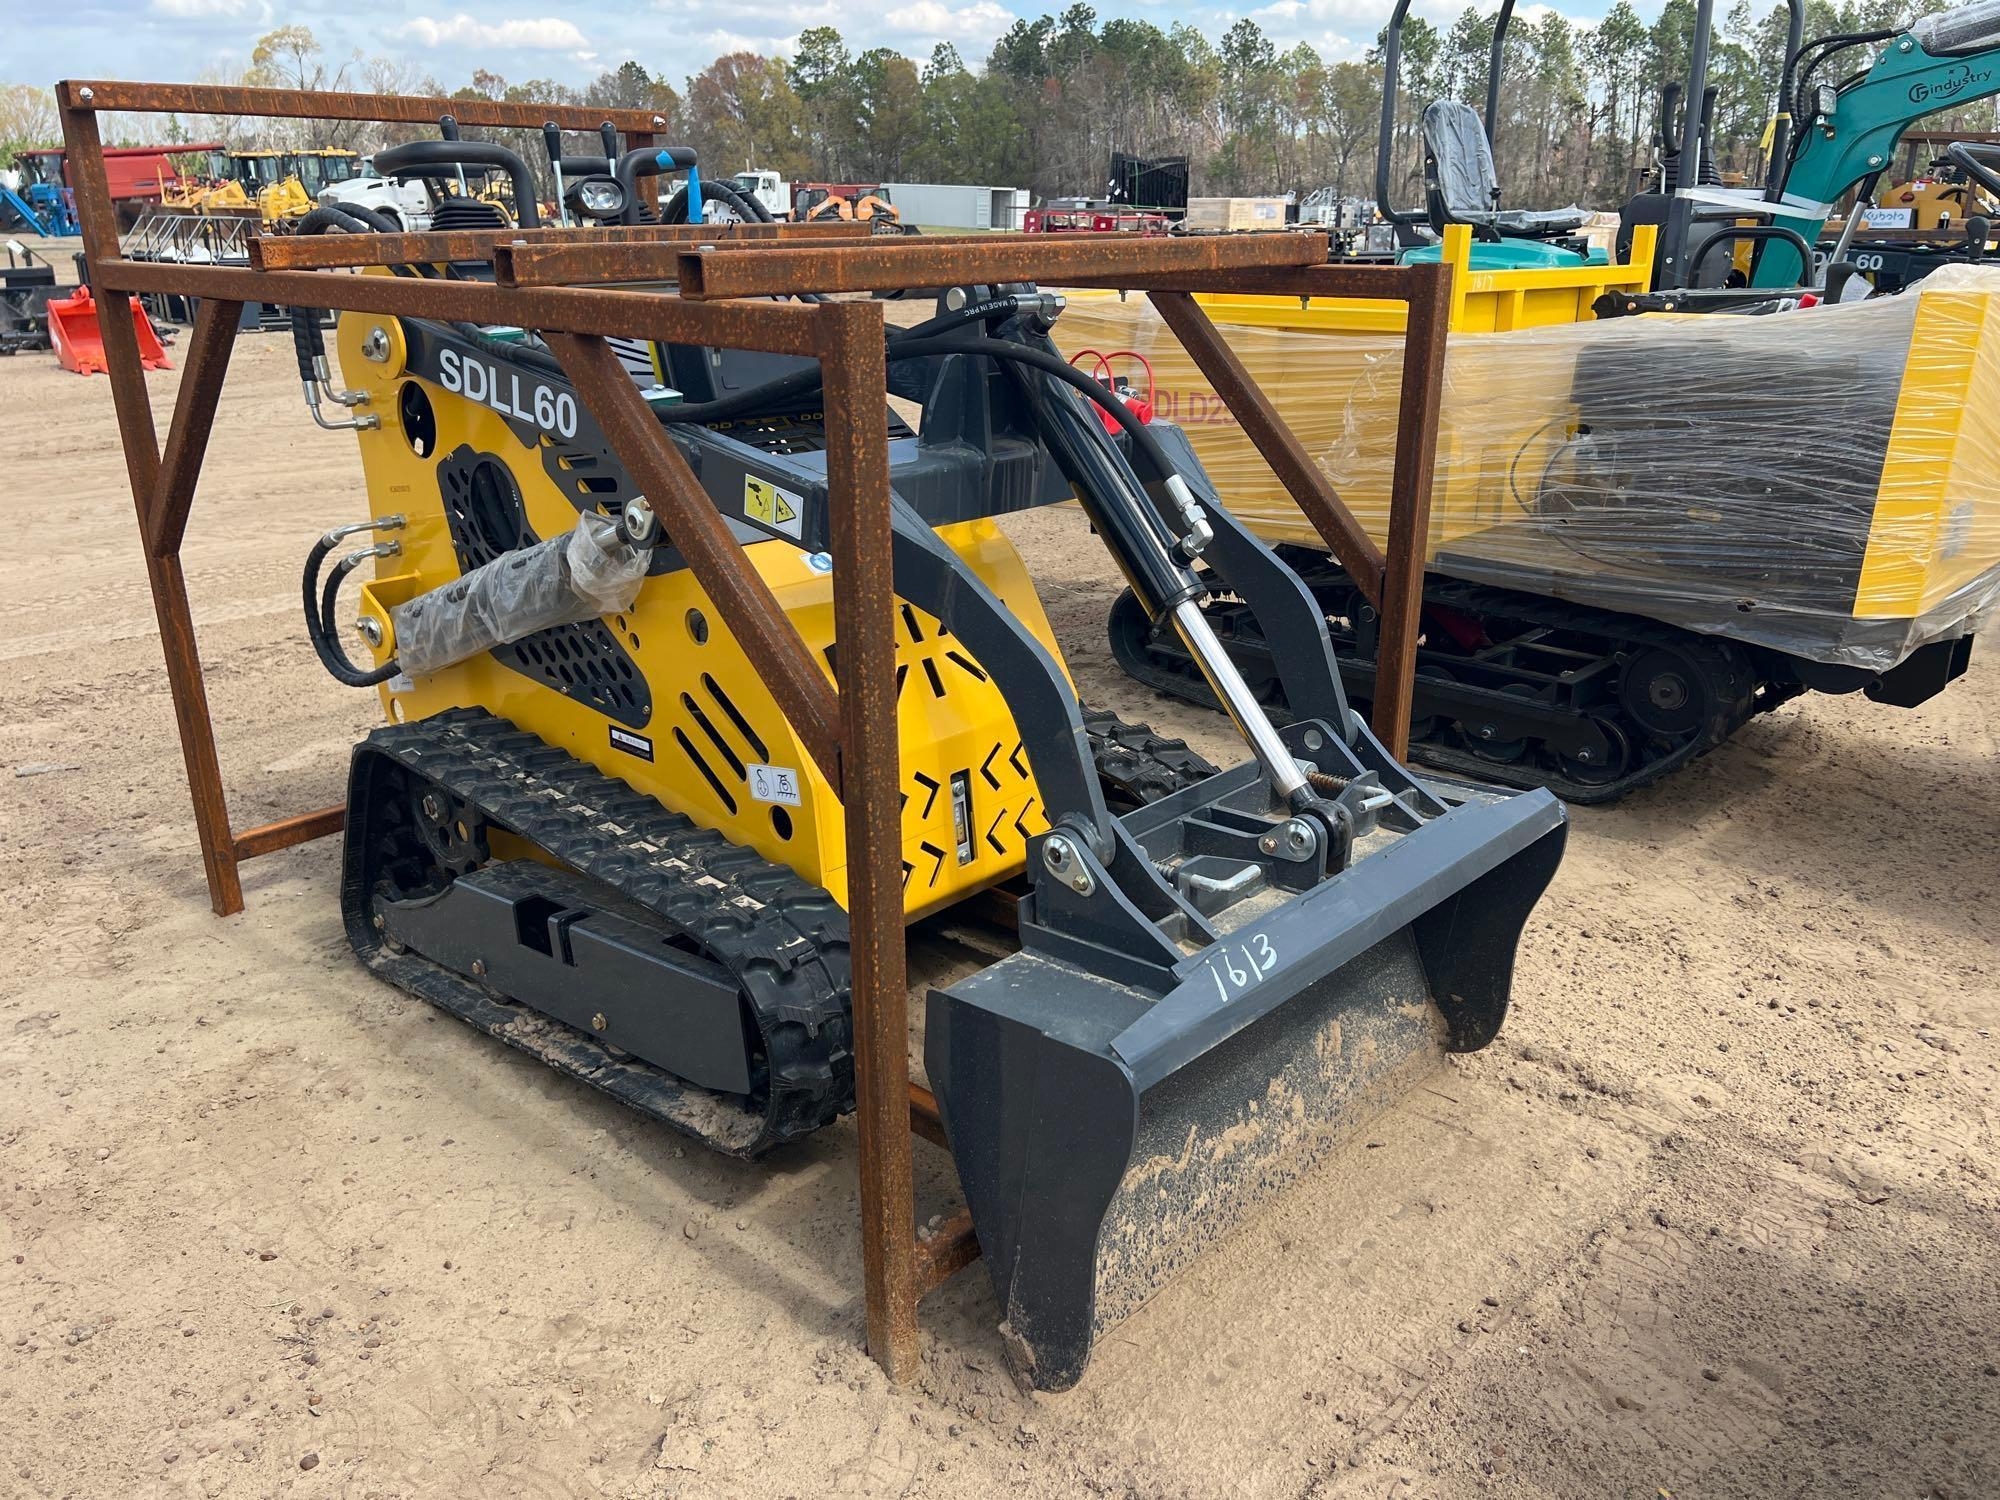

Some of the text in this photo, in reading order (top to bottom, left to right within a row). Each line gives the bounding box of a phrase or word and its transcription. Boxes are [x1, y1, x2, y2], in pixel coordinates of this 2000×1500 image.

[1863, 211, 1904, 220] Kubota
[963, 307, 980, 317] PRC
[439, 348, 578, 438] SDLL60
[1206, 933, 1278, 1003] 1613
